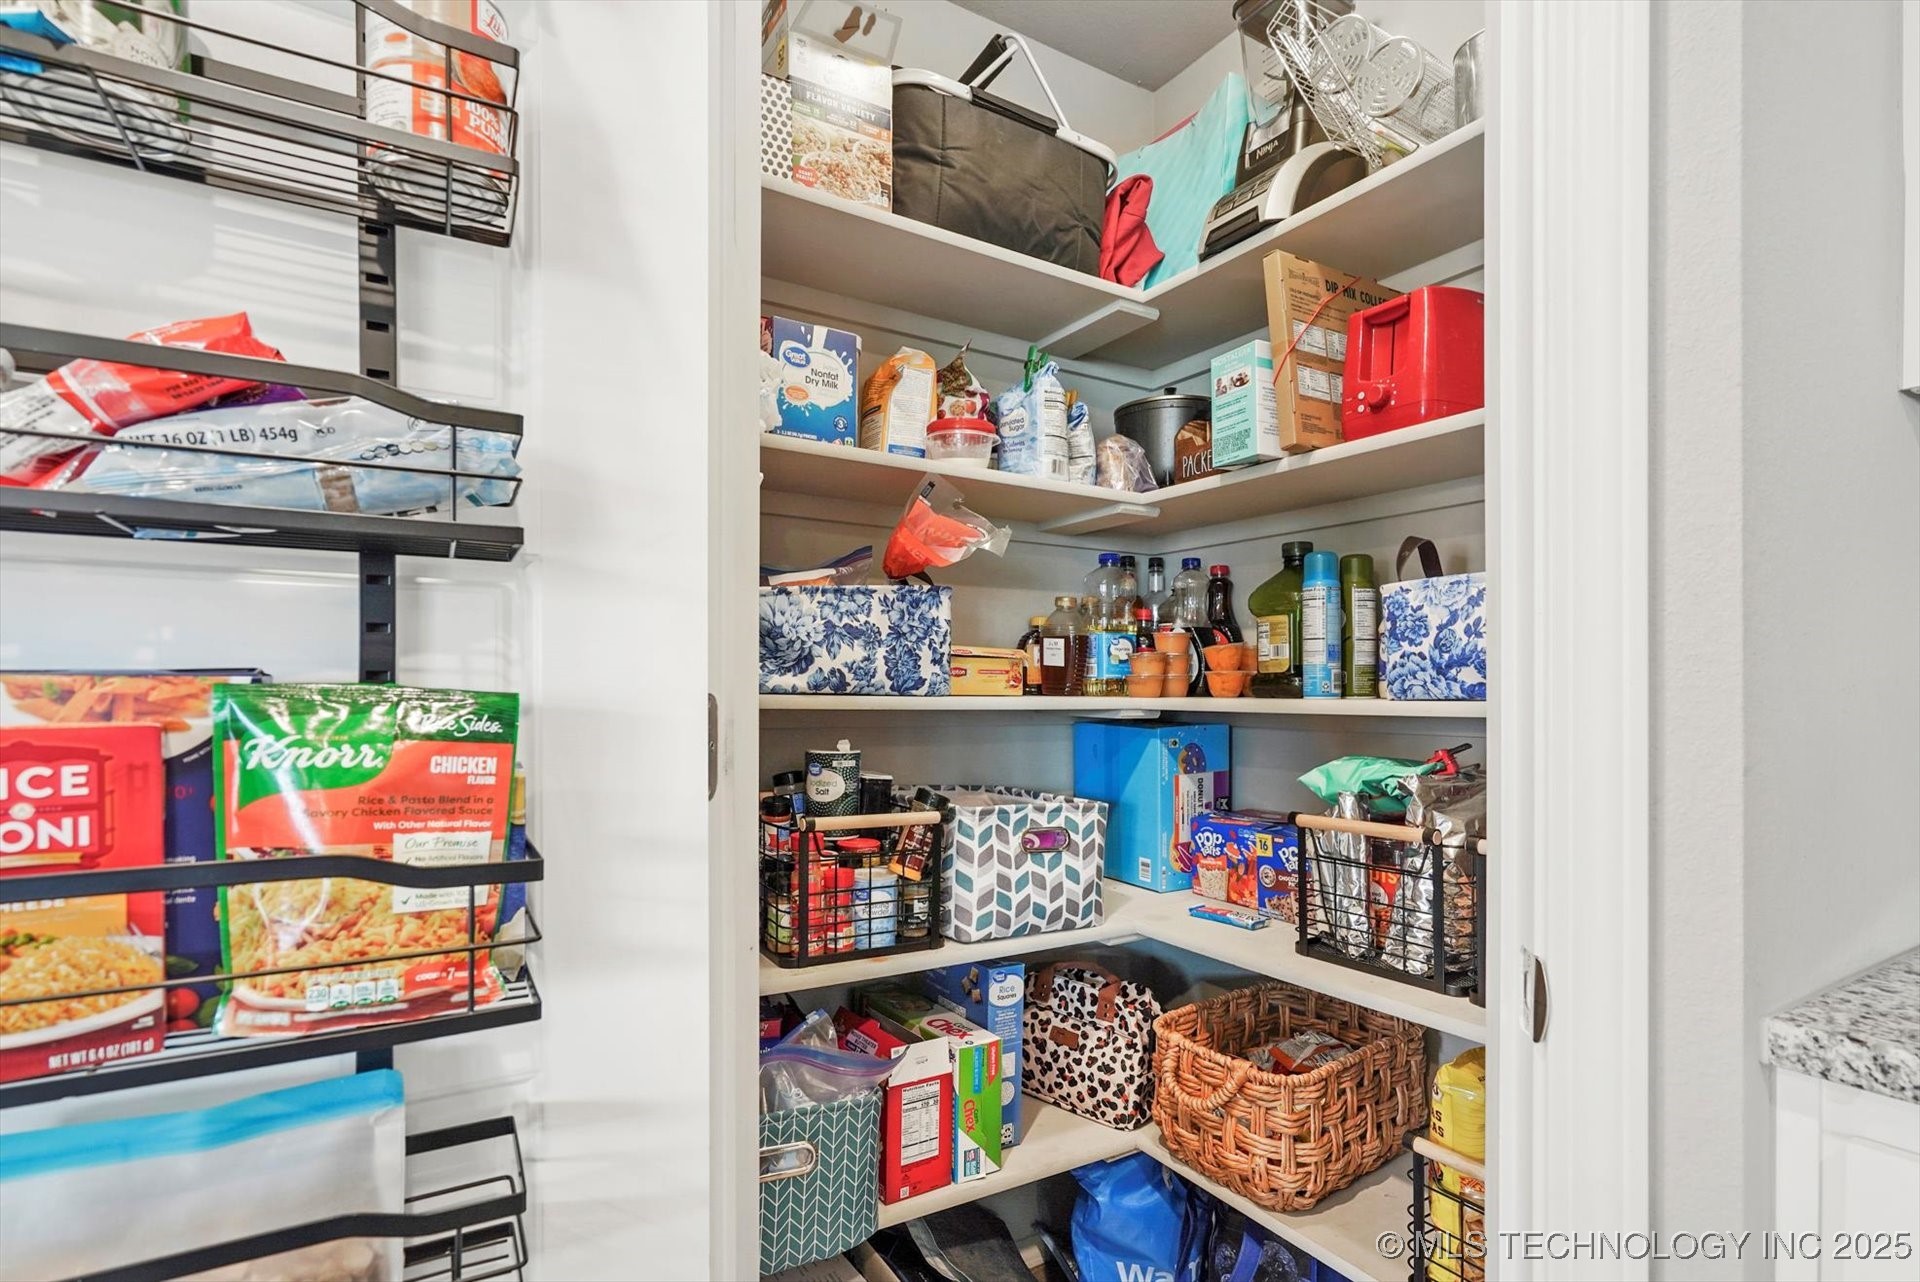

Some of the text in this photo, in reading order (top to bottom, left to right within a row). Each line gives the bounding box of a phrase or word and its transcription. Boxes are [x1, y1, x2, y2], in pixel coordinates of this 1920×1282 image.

[1325, 280, 1339, 294] DIP
[811, 368, 839, 381] Nonfat
[805, 375, 839, 390] Dry Milk
[186, 432, 208, 446] OZ
[231, 427, 256, 443] LB)
[259, 426, 299, 443] 454g
[1182, 449, 1213, 479] PACKE
[453, 713, 503, 737] Sides
[243, 733, 384, 771] Knorr
[429, 755, 498, 775] CHICKEN
[466, 775, 497, 785] FLAVOR
[815, 787, 830, 796] Salt
[358, 795, 385, 805] Rice
[401, 795, 436, 805] Pasta
[438, 795, 470, 805] Blend
[473, 795, 483, 804] in
[351, 807, 401, 817] Chicken
[404, 806, 456, 816] Flavored
[458, 806, 493, 816] Sauce
[373, 818, 492, 830] With Other Natural Flavor
[404, 837, 479, 849] Our Promise
[1259, 839, 1269, 851] 16
[447, 967, 456, 981] 7
[998, 985, 1016, 994] Rice
[997, 993, 1017, 1001] Squares
[926, 1018, 974, 1040] Chex
[48, 1051, 69, 1069] NET
[69, 1048, 88, 1066] WT
[902, 1084, 925, 1093] Nutrition
[963, 1099, 975, 1133] Chex
